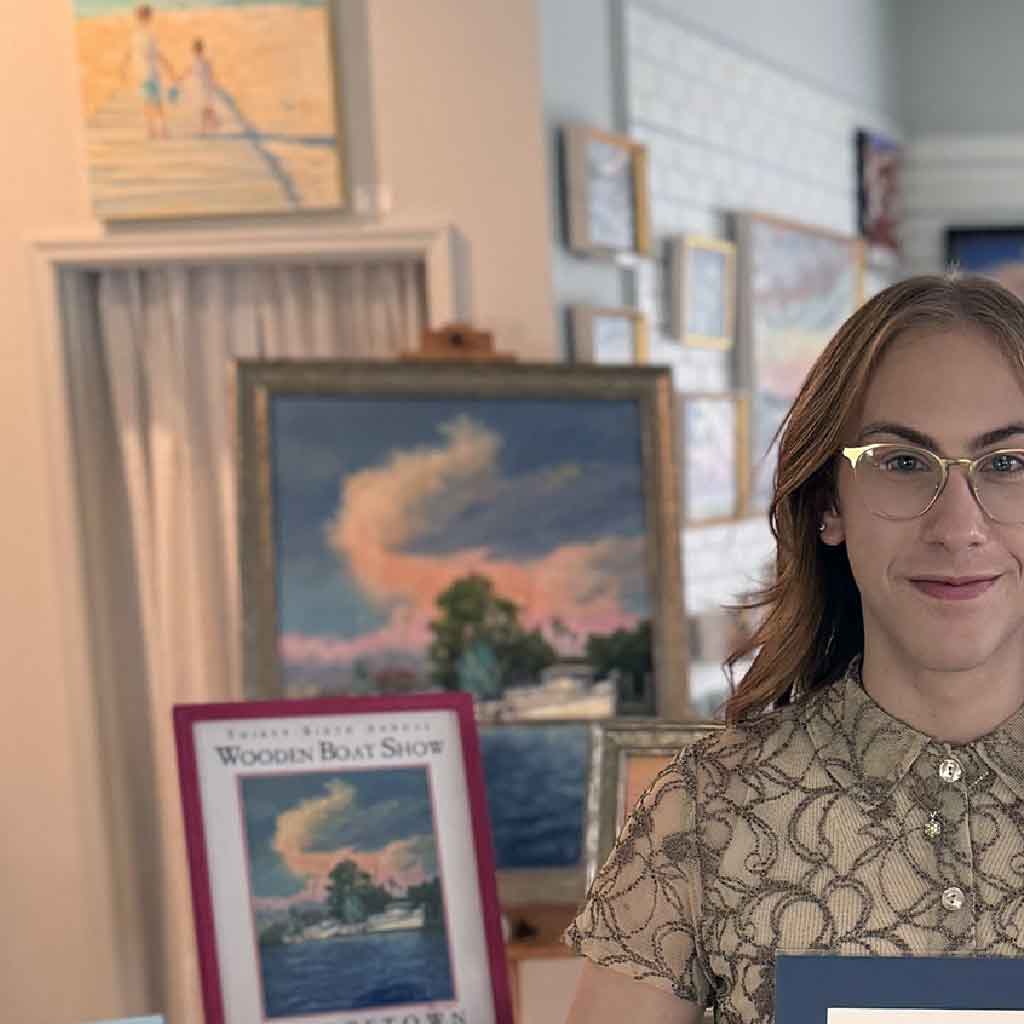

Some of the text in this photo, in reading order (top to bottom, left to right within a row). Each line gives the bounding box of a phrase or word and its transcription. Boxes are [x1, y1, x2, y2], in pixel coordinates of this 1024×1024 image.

[214, 735, 445, 767] WOODEN BOAT SHOW
